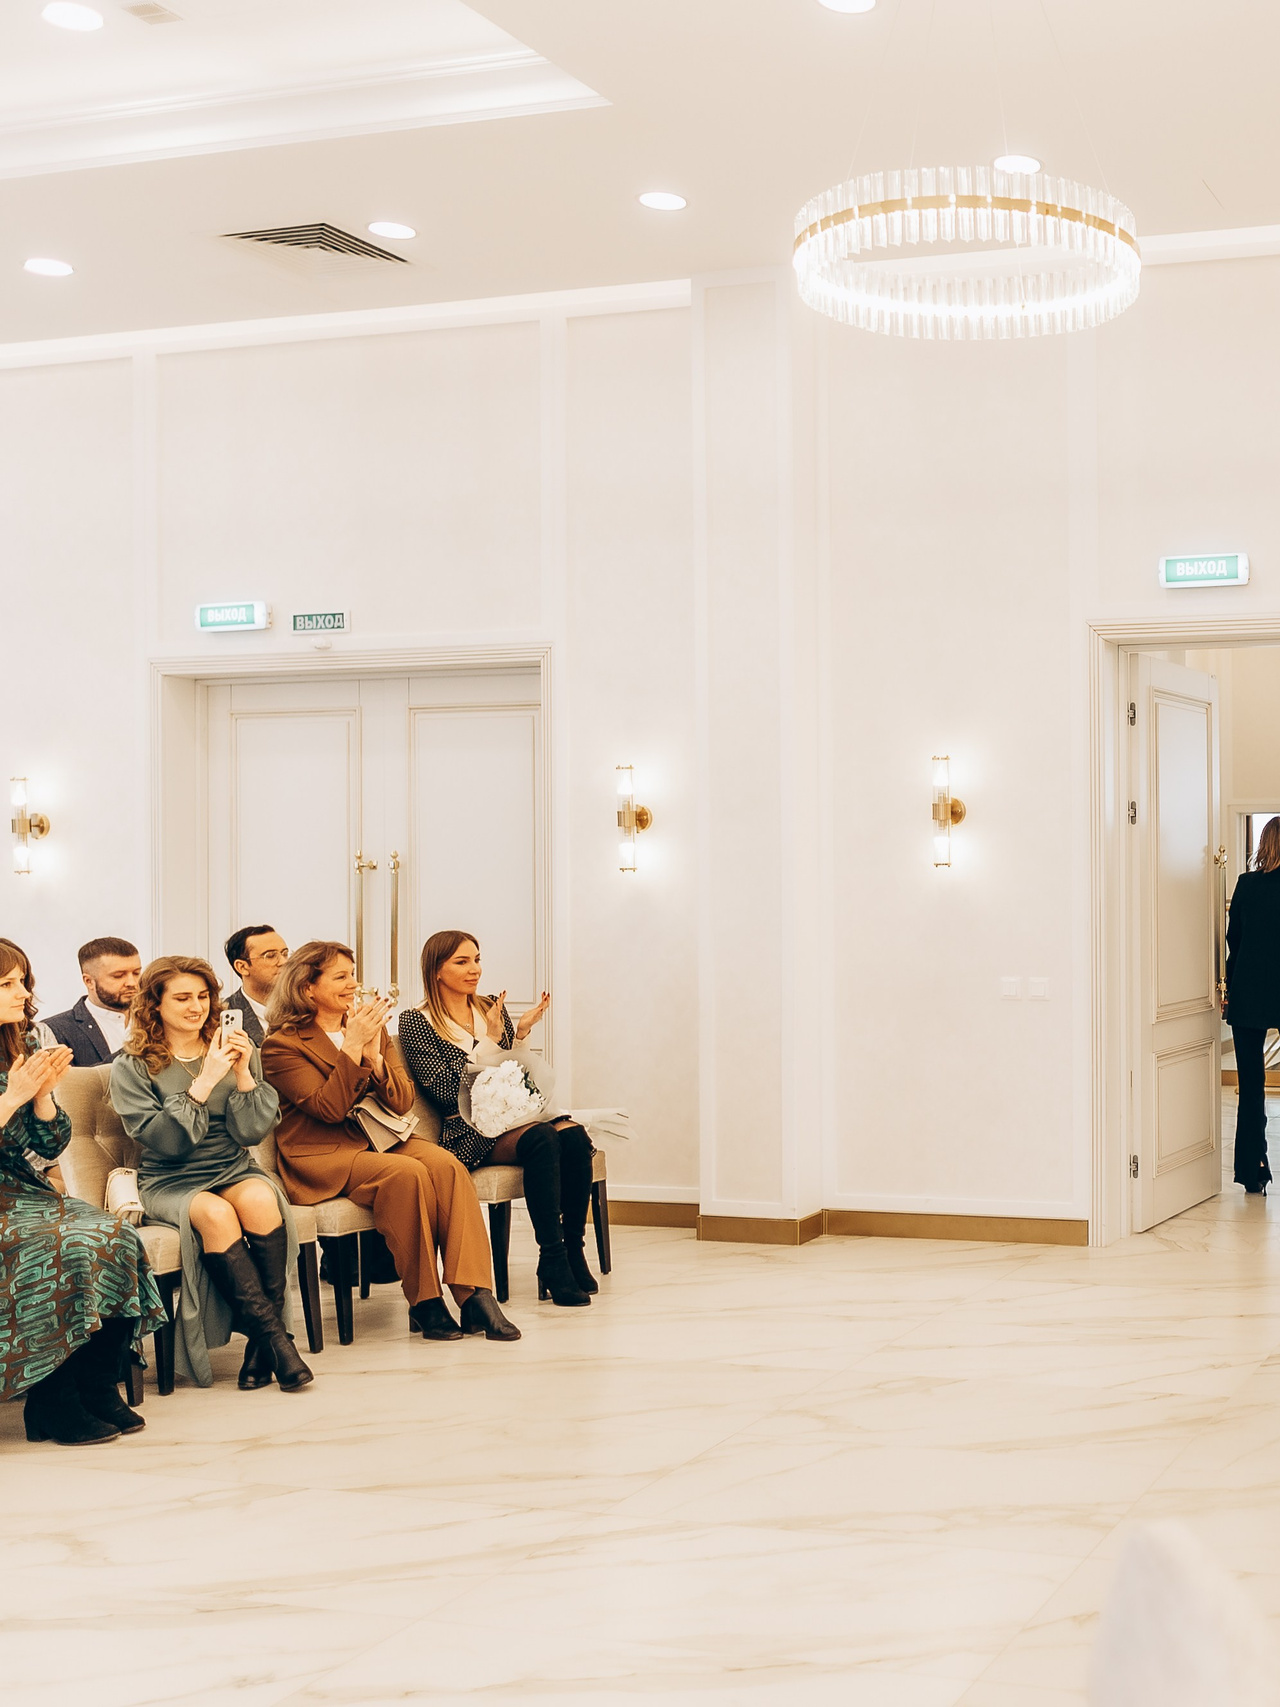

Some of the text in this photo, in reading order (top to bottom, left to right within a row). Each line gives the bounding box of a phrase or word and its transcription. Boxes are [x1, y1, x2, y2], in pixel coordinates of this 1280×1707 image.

[1176, 559, 1228, 577] ВЫХОД
[207, 607, 247, 623] ВЫХОД
[295, 614, 344, 631] ВЫХОД
